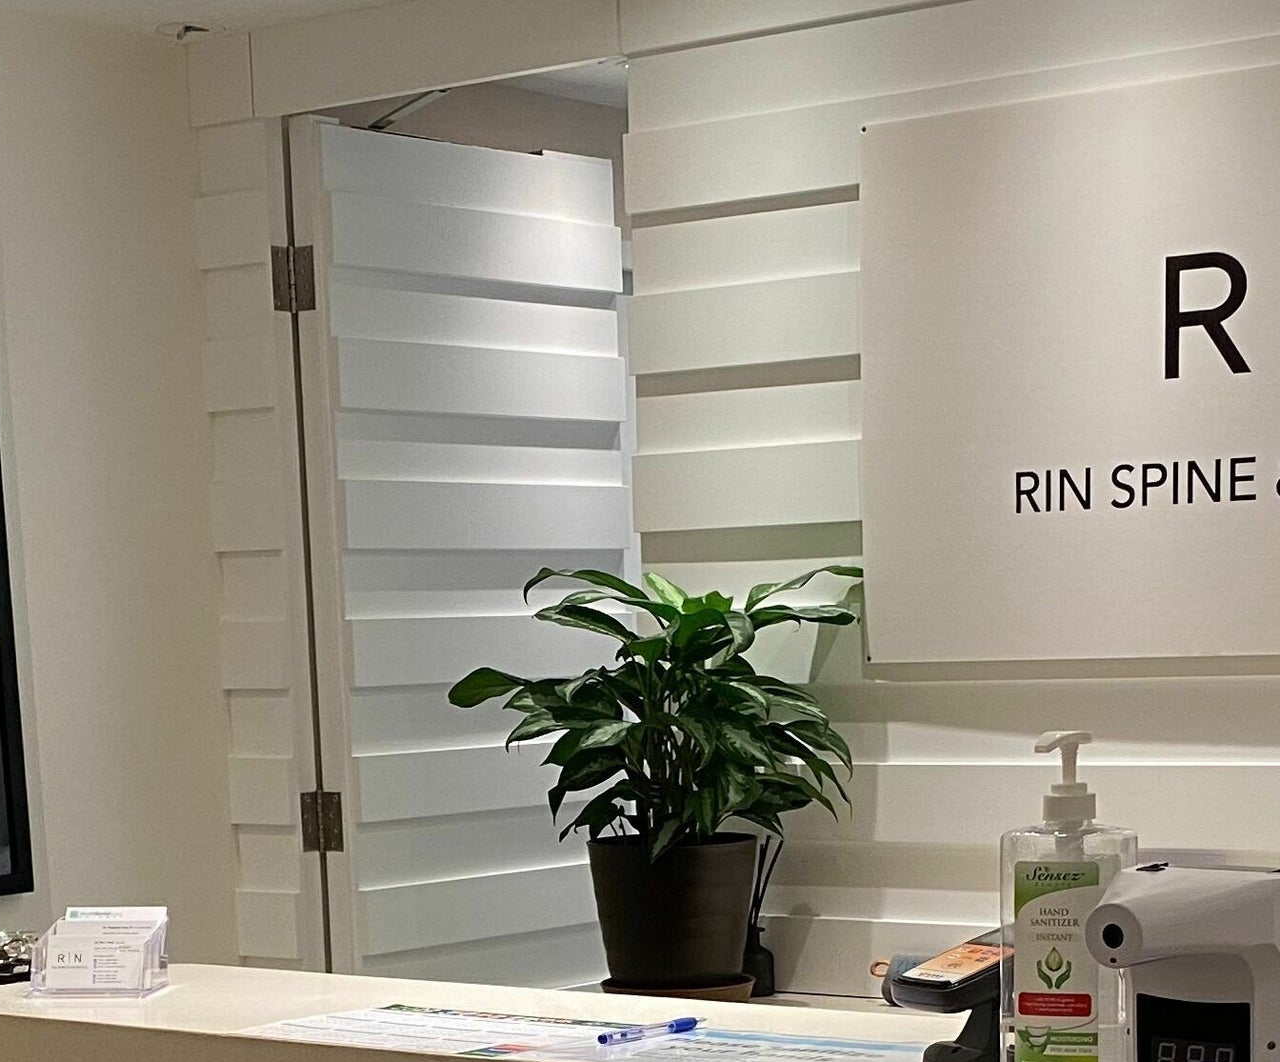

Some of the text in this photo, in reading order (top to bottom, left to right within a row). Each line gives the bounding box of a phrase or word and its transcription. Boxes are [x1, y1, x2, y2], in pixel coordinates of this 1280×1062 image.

[1015, 467, 1092, 513] RIN
[1110, 456, 1257, 509] SPINE
[1039, 907, 1069, 916] HAND
[1030, 917, 1080, 927] SANITIZER
[1036, 933, 1073, 942] INSTANT
